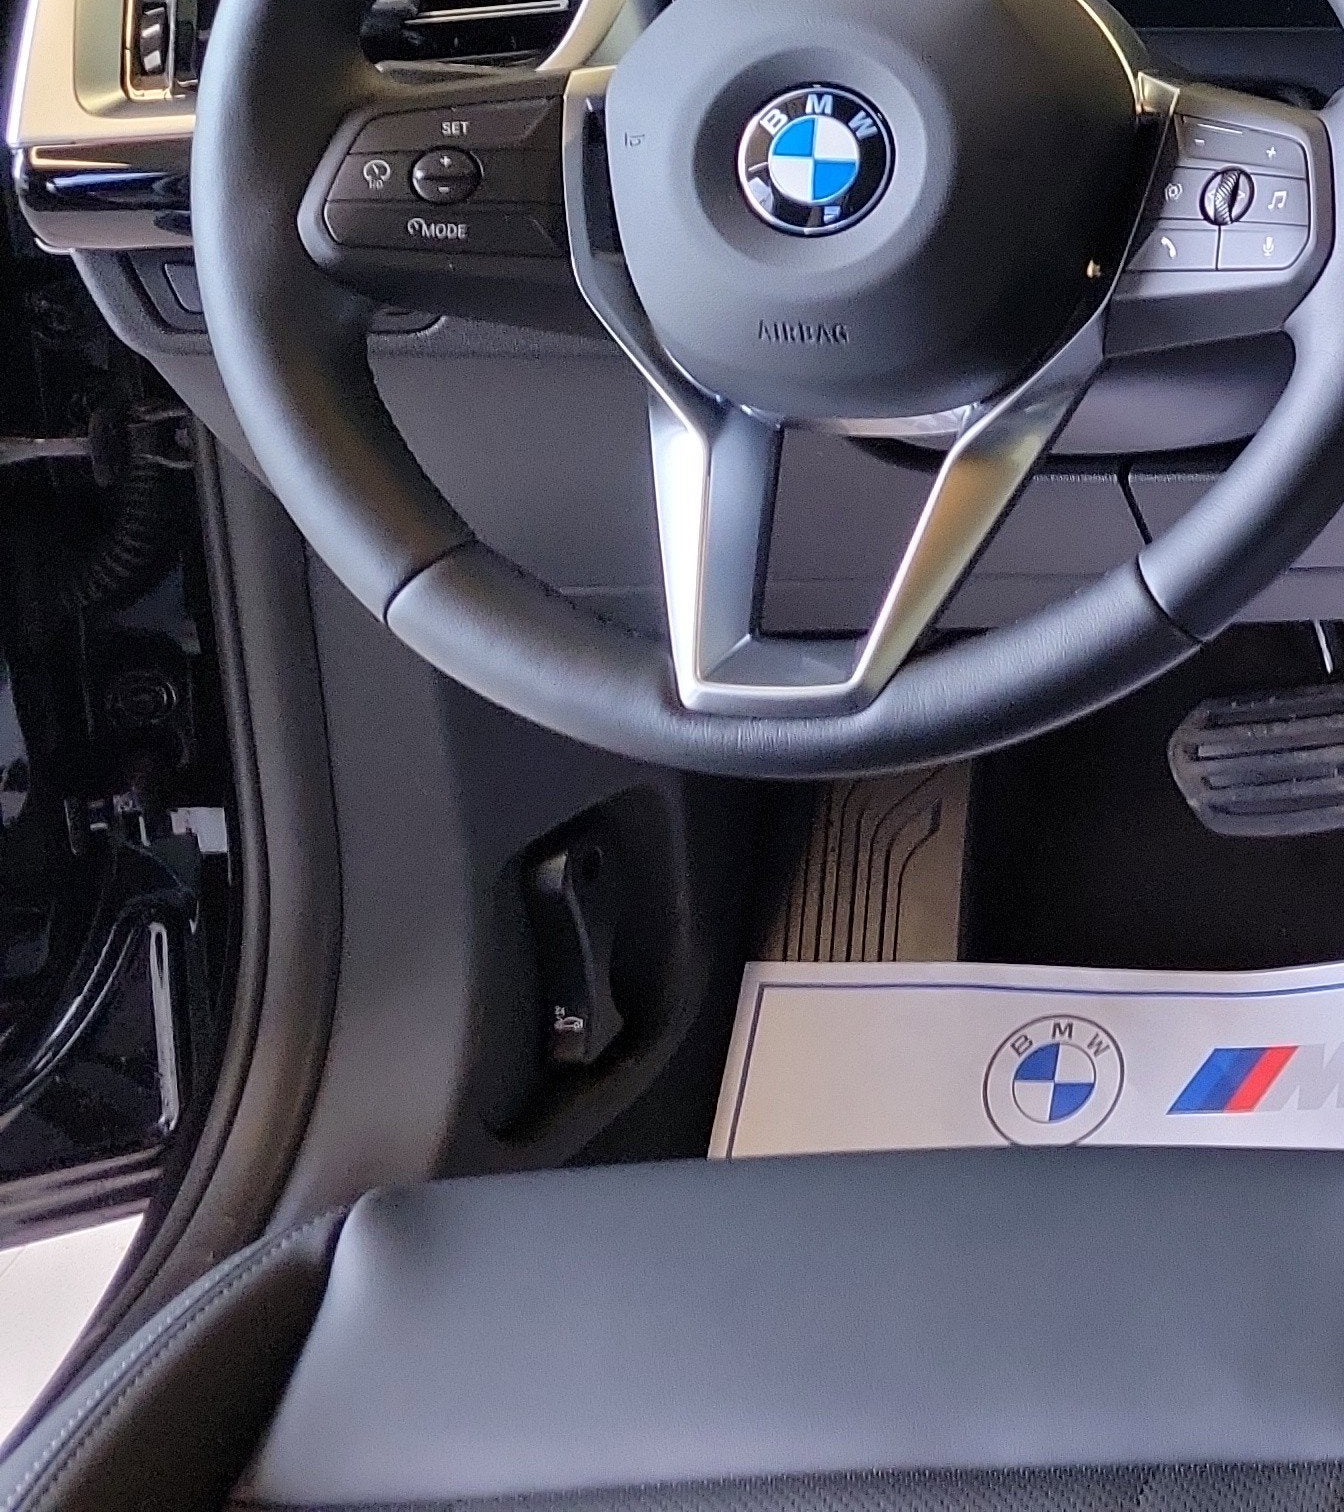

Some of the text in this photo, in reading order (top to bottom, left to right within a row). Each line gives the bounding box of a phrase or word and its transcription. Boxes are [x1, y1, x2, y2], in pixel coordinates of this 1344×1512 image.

[442, 121, 469, 136] SET
[760, 94, 878, 139] BMW
[421, 222, 467, 239] MODE
[758, 319, 851, 346] AIRBAG
[1010, 1022, 1110, 1058] BMW
